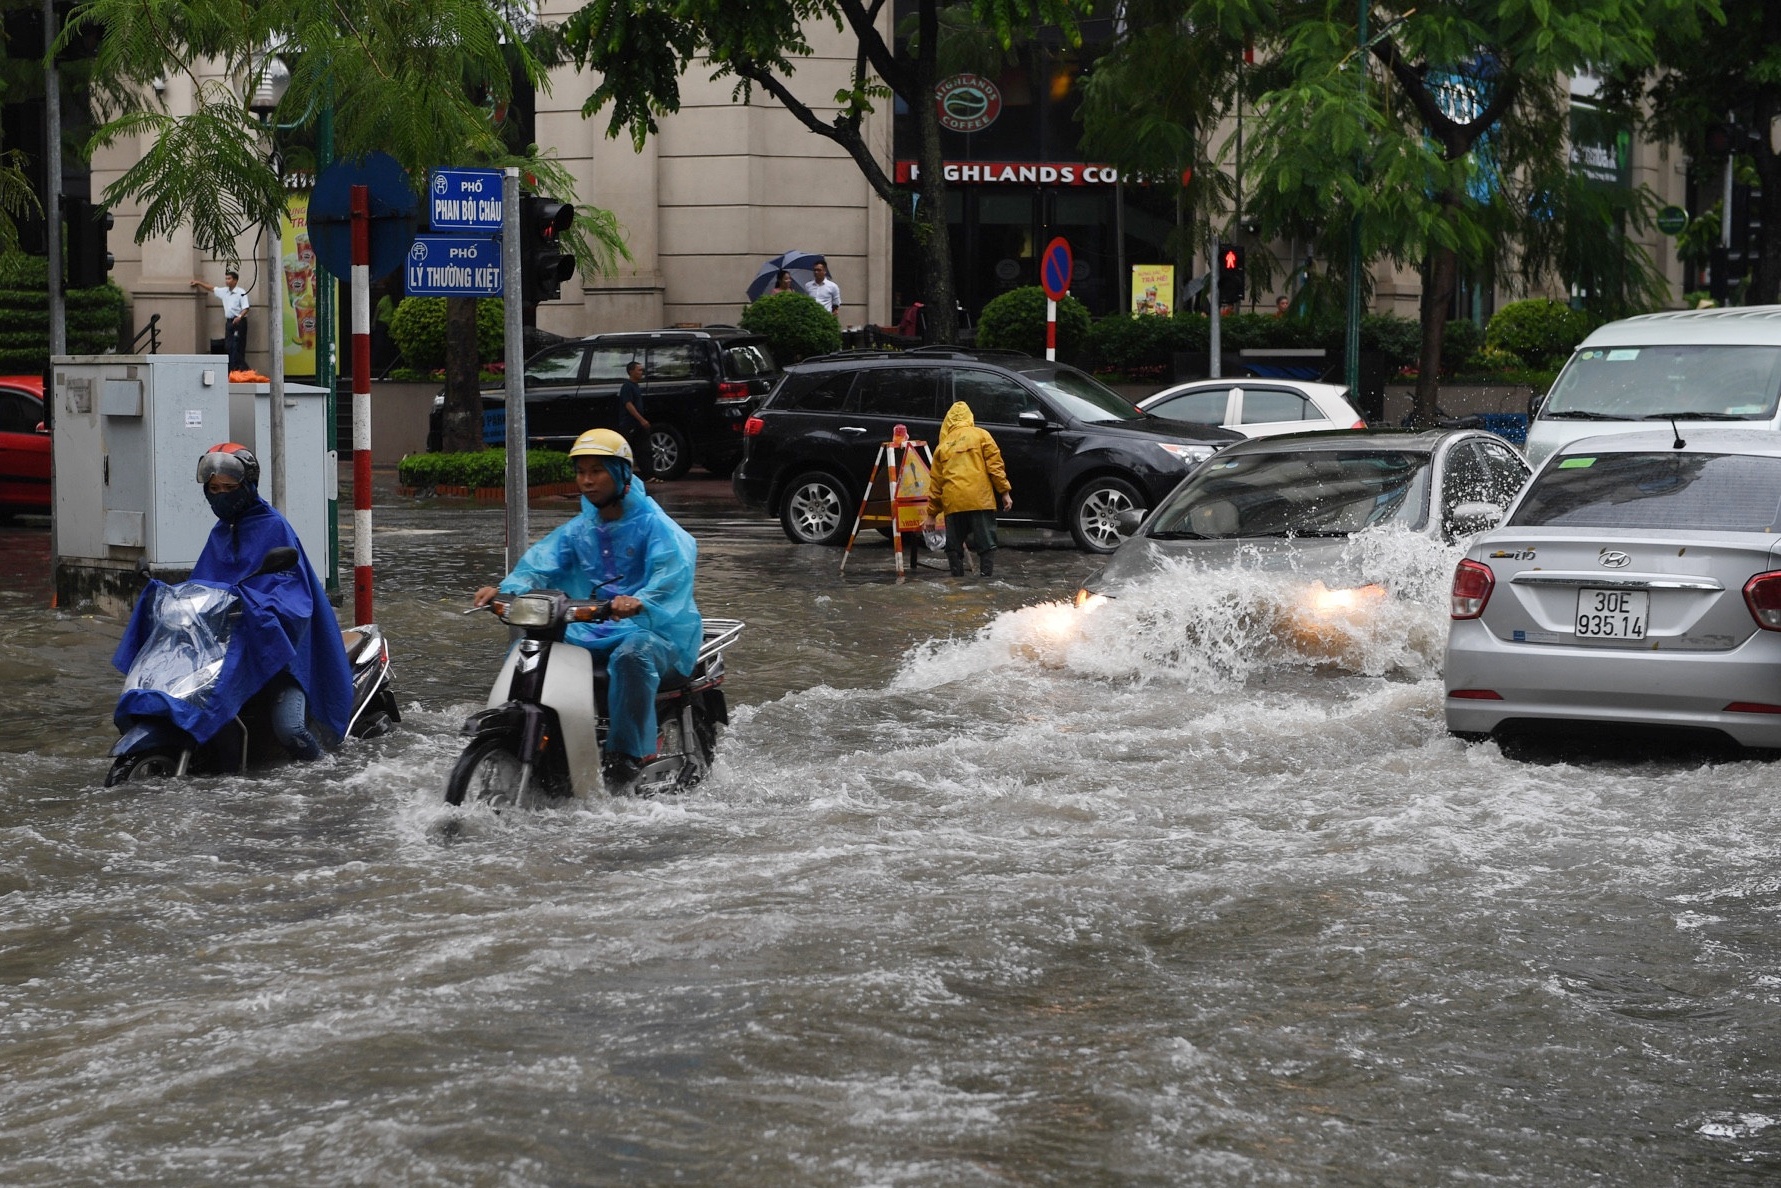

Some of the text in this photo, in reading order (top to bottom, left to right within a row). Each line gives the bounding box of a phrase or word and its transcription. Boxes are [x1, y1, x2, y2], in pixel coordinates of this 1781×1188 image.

[942, 115, 990, 129] COFFEE
[910, 164, 1074, 183] HGHLANDS
[460, 178, 484, 193] PHỐ
[435, 196, 502, 225] PHAN BỘI CHÂU
[449, 243, 478, 258] PHỐ
[410, 262, 500, 292] LÝ THƯỜNG KIỆT
[1594, 591, 1632, 613] 30E
[1578, 614, 1643, 638] 935.14
